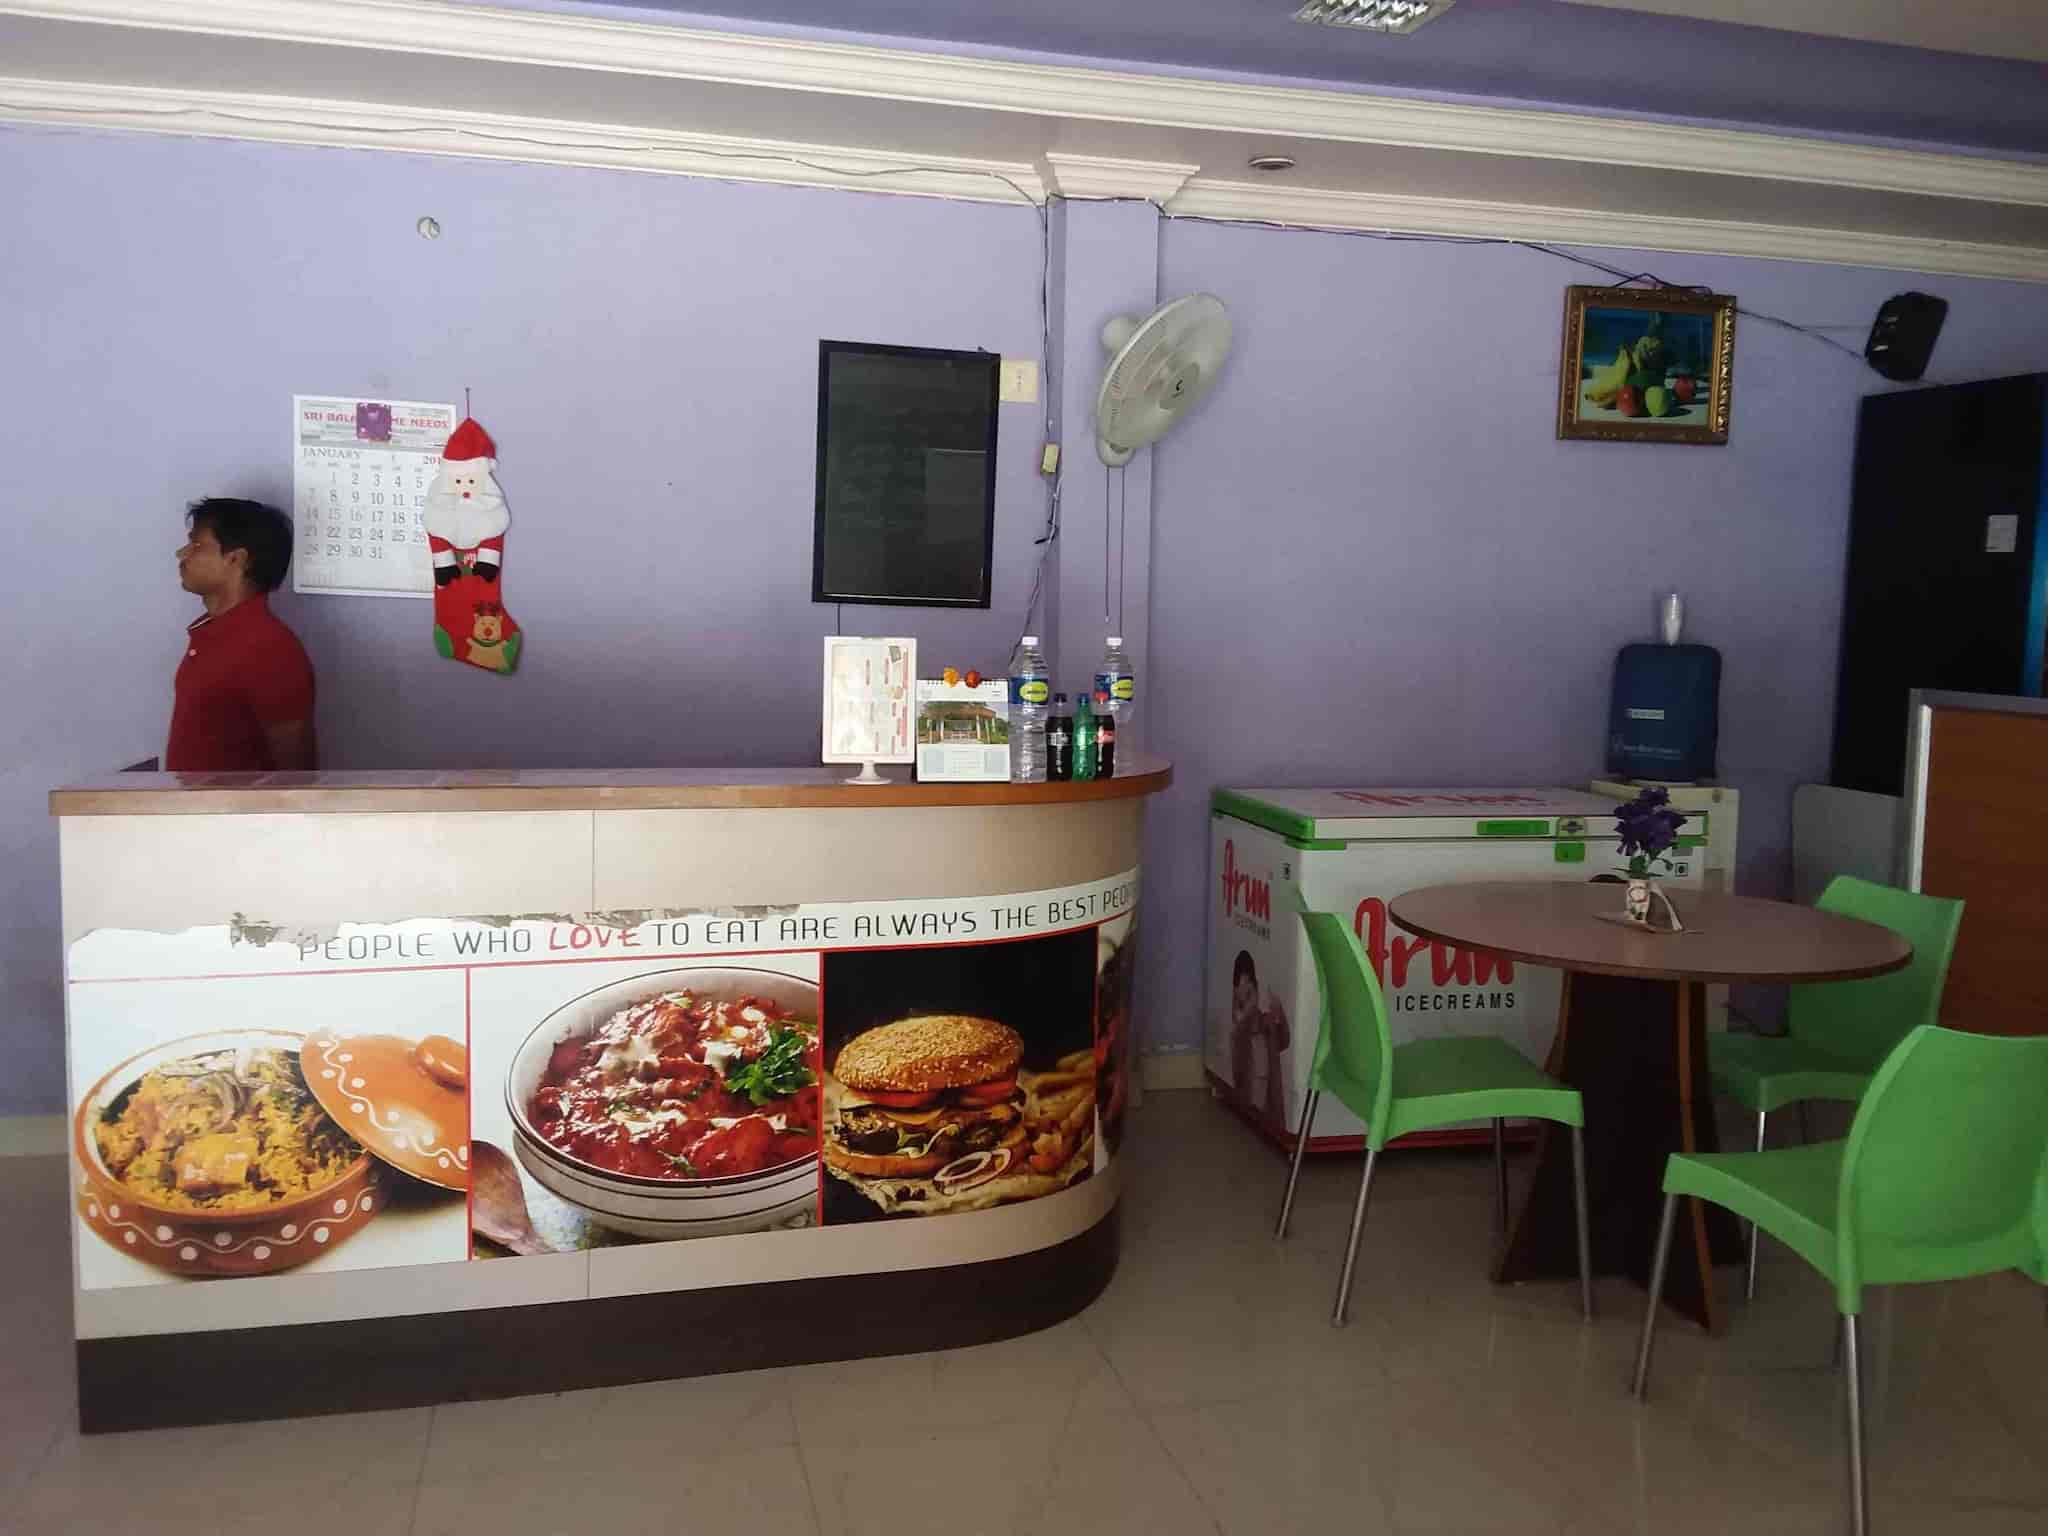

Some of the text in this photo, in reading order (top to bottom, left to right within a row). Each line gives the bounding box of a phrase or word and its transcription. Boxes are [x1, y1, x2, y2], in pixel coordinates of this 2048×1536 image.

[303, 447, 361, 460] JANUARY
[351, 472, 360, 485] 2
[373, 473, 382, 487] 3
[393, 475, 402, 488] 4
[415, 477, 424, 488] 5
[329, 488, 338, 502] 8
[351, 490, 360, 503] 9
[370, 492, 384, 504] 10
[392, 493, 406, 506] 11
[370, 510, 384, 522] 17
[392, 511, 406, 524] 18
[326, 526, 342, 538] 22
[348, 527, 363, 540] 23
[369, 528, 384, 541] 24
[391, 529, 406, 542] 25
[326, 544, 342, 557] 29
[368, 546, 383, 559] 31
[1222, 838, 1271, 923] Arun
[298, 884, 1129, 961] PEOPLE WHO LOVE TO EAT ARE ALWAYS THE BEST PEO
[1395, 991, 1515, 1012] ICECREAMS
